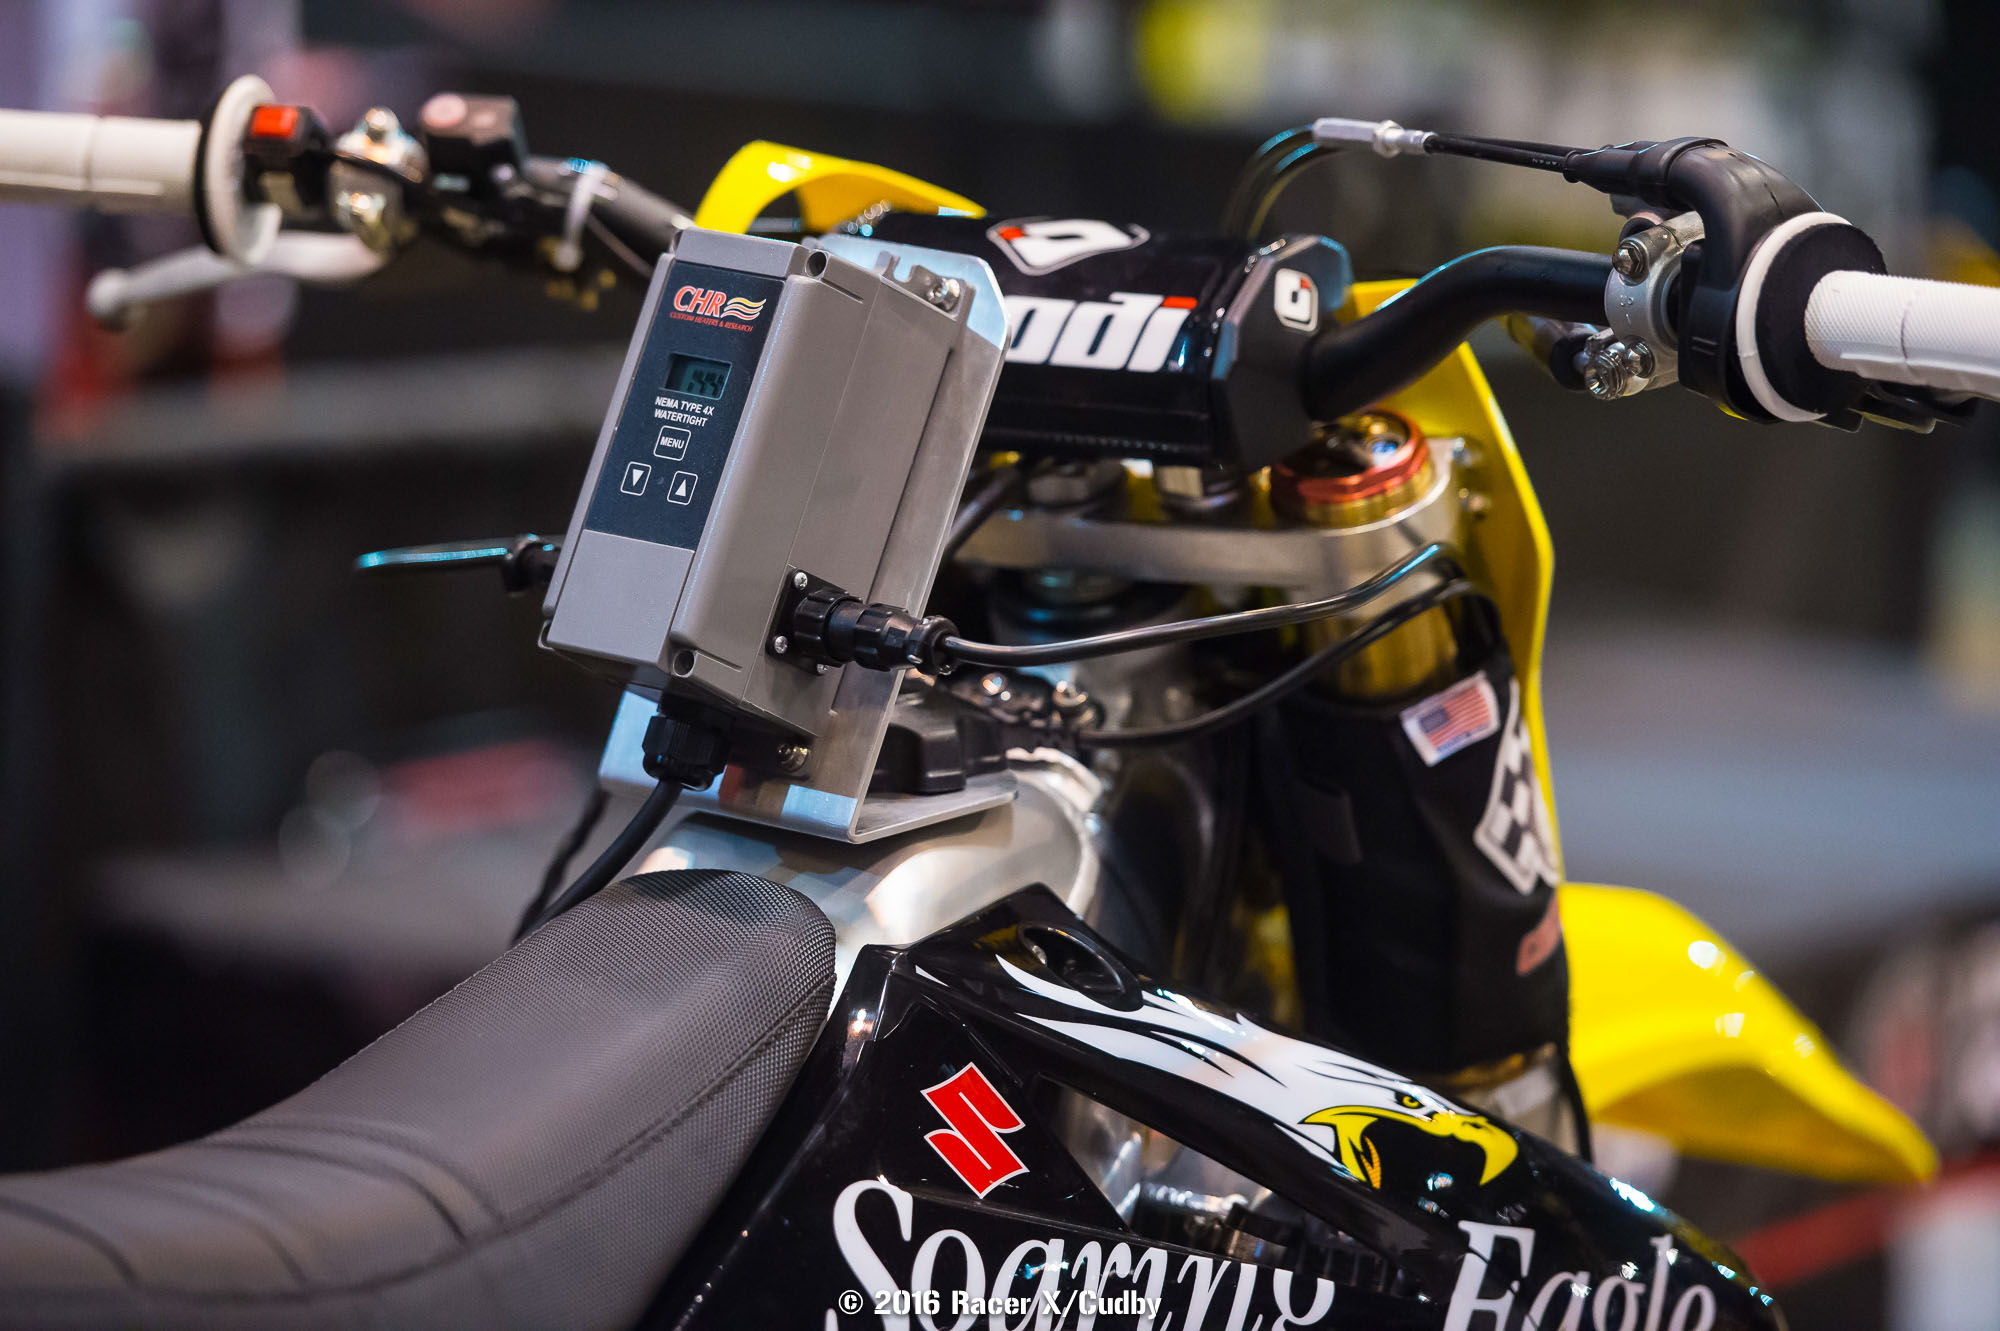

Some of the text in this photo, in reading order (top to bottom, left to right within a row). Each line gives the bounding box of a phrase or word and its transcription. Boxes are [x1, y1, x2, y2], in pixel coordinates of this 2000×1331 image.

[673, 285, 727, 318] CHR
[669, 311, 695, 321] CUSTOM
[694, 316, 718, 327] HEATERS
[724, 321, 754, 333] RESEARCH
[654, 396, 715, 416] NEMA TYPE 4X
[654, 408, 708, 427] WATERTIGHT
[660, 436, 685, 449] MENU
